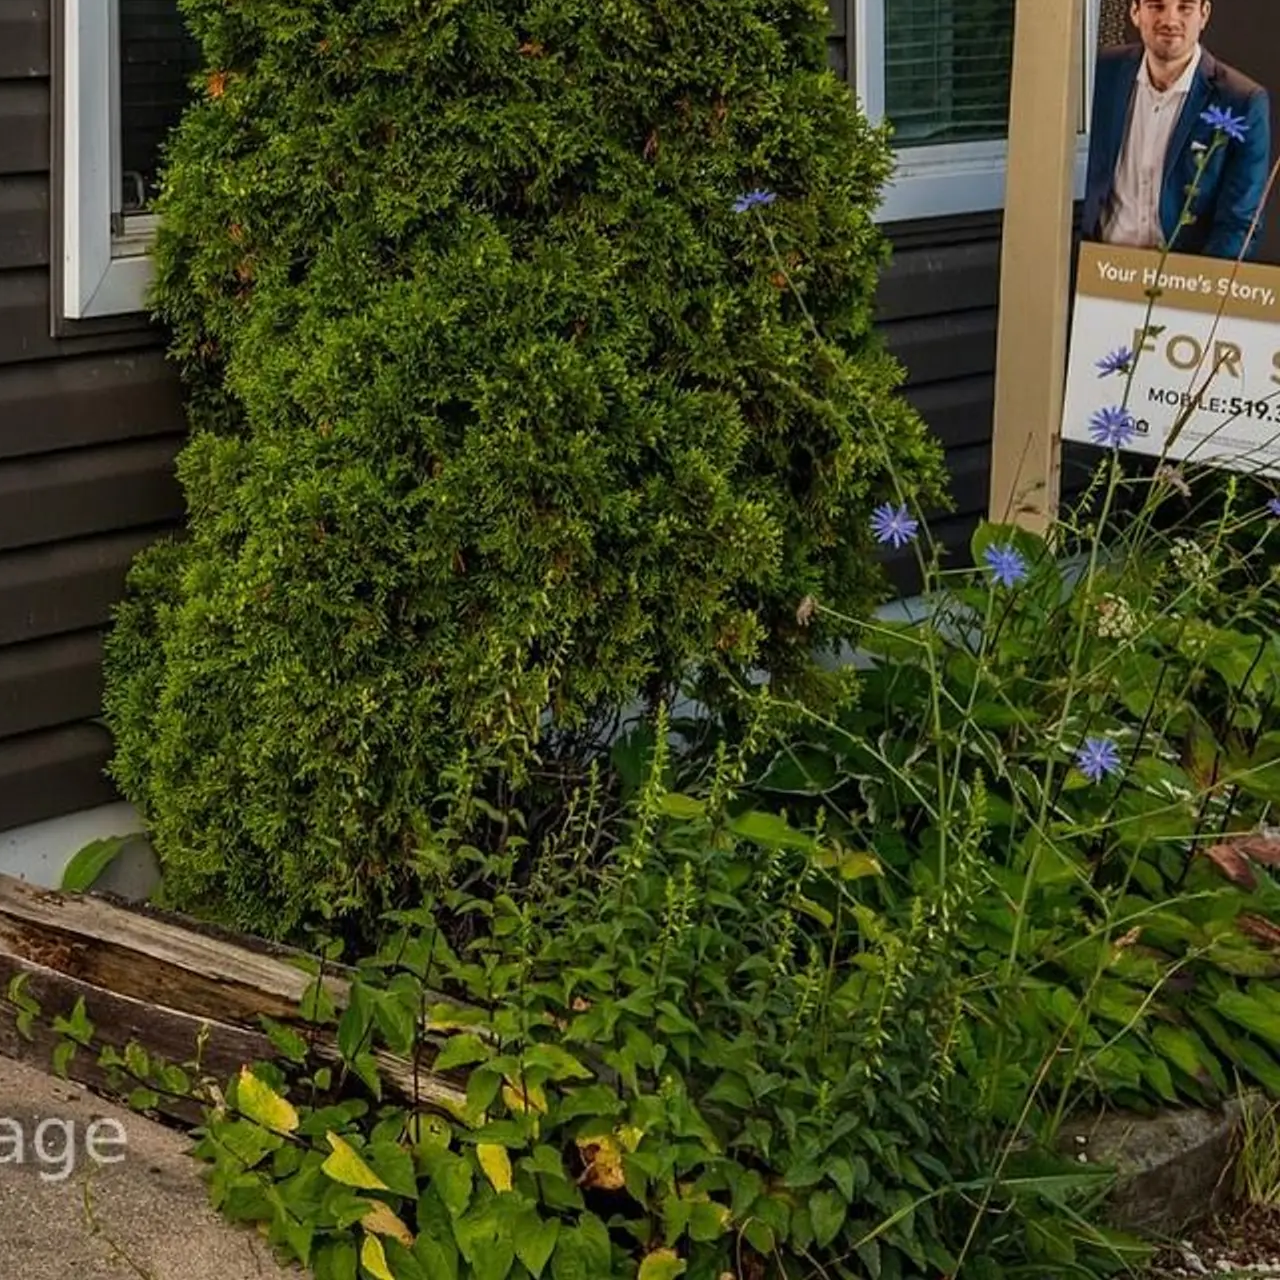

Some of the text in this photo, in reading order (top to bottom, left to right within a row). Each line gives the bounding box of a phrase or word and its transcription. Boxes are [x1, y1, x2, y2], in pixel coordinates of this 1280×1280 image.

[1097, 261, 1277, 307] Your Home's Story,
